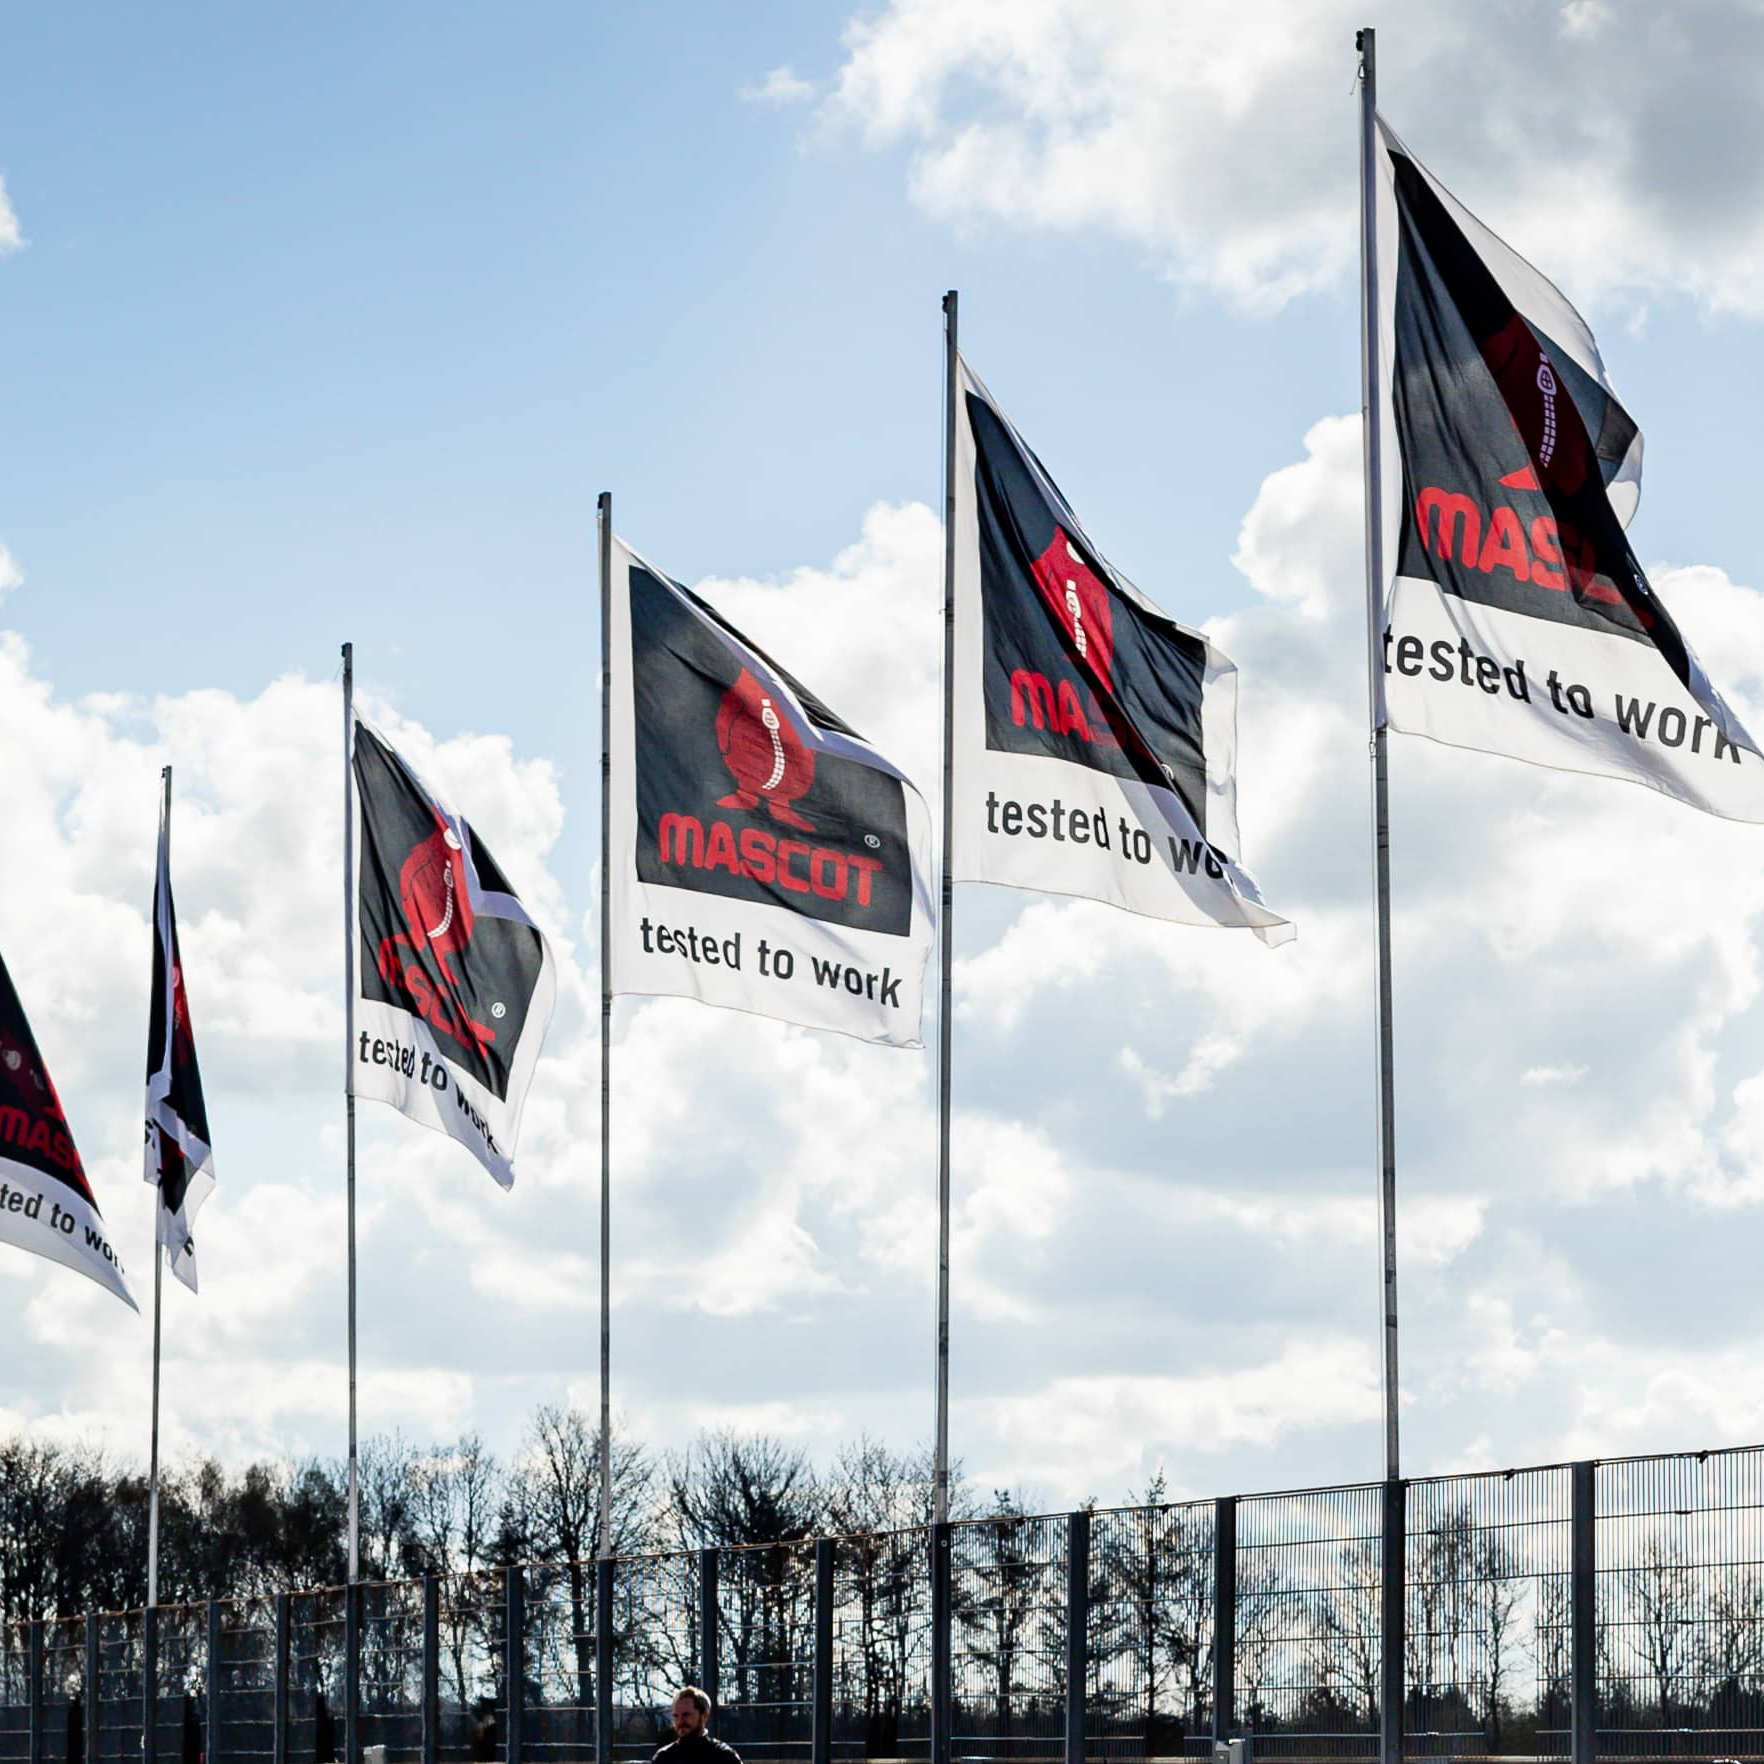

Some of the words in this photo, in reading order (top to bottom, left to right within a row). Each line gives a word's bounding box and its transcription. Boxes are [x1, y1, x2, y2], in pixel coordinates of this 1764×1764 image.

[1382, 622, 1532, 705] tested
[1546, 669, 1595, 720] to
[658, 812, 883, 907] MASCOT
[985, 791, 1111, 851] tested
[1118, 816, 1152, 865] to
[640, 917, 742, 971] tested
[757, 939, 794, 980] to
[811, 956, 903, 1009] work
[359, 1030, 415, 1079] tested
[421, 1051, 448, 1091] to
[50, 1203, 76, 1235] to
